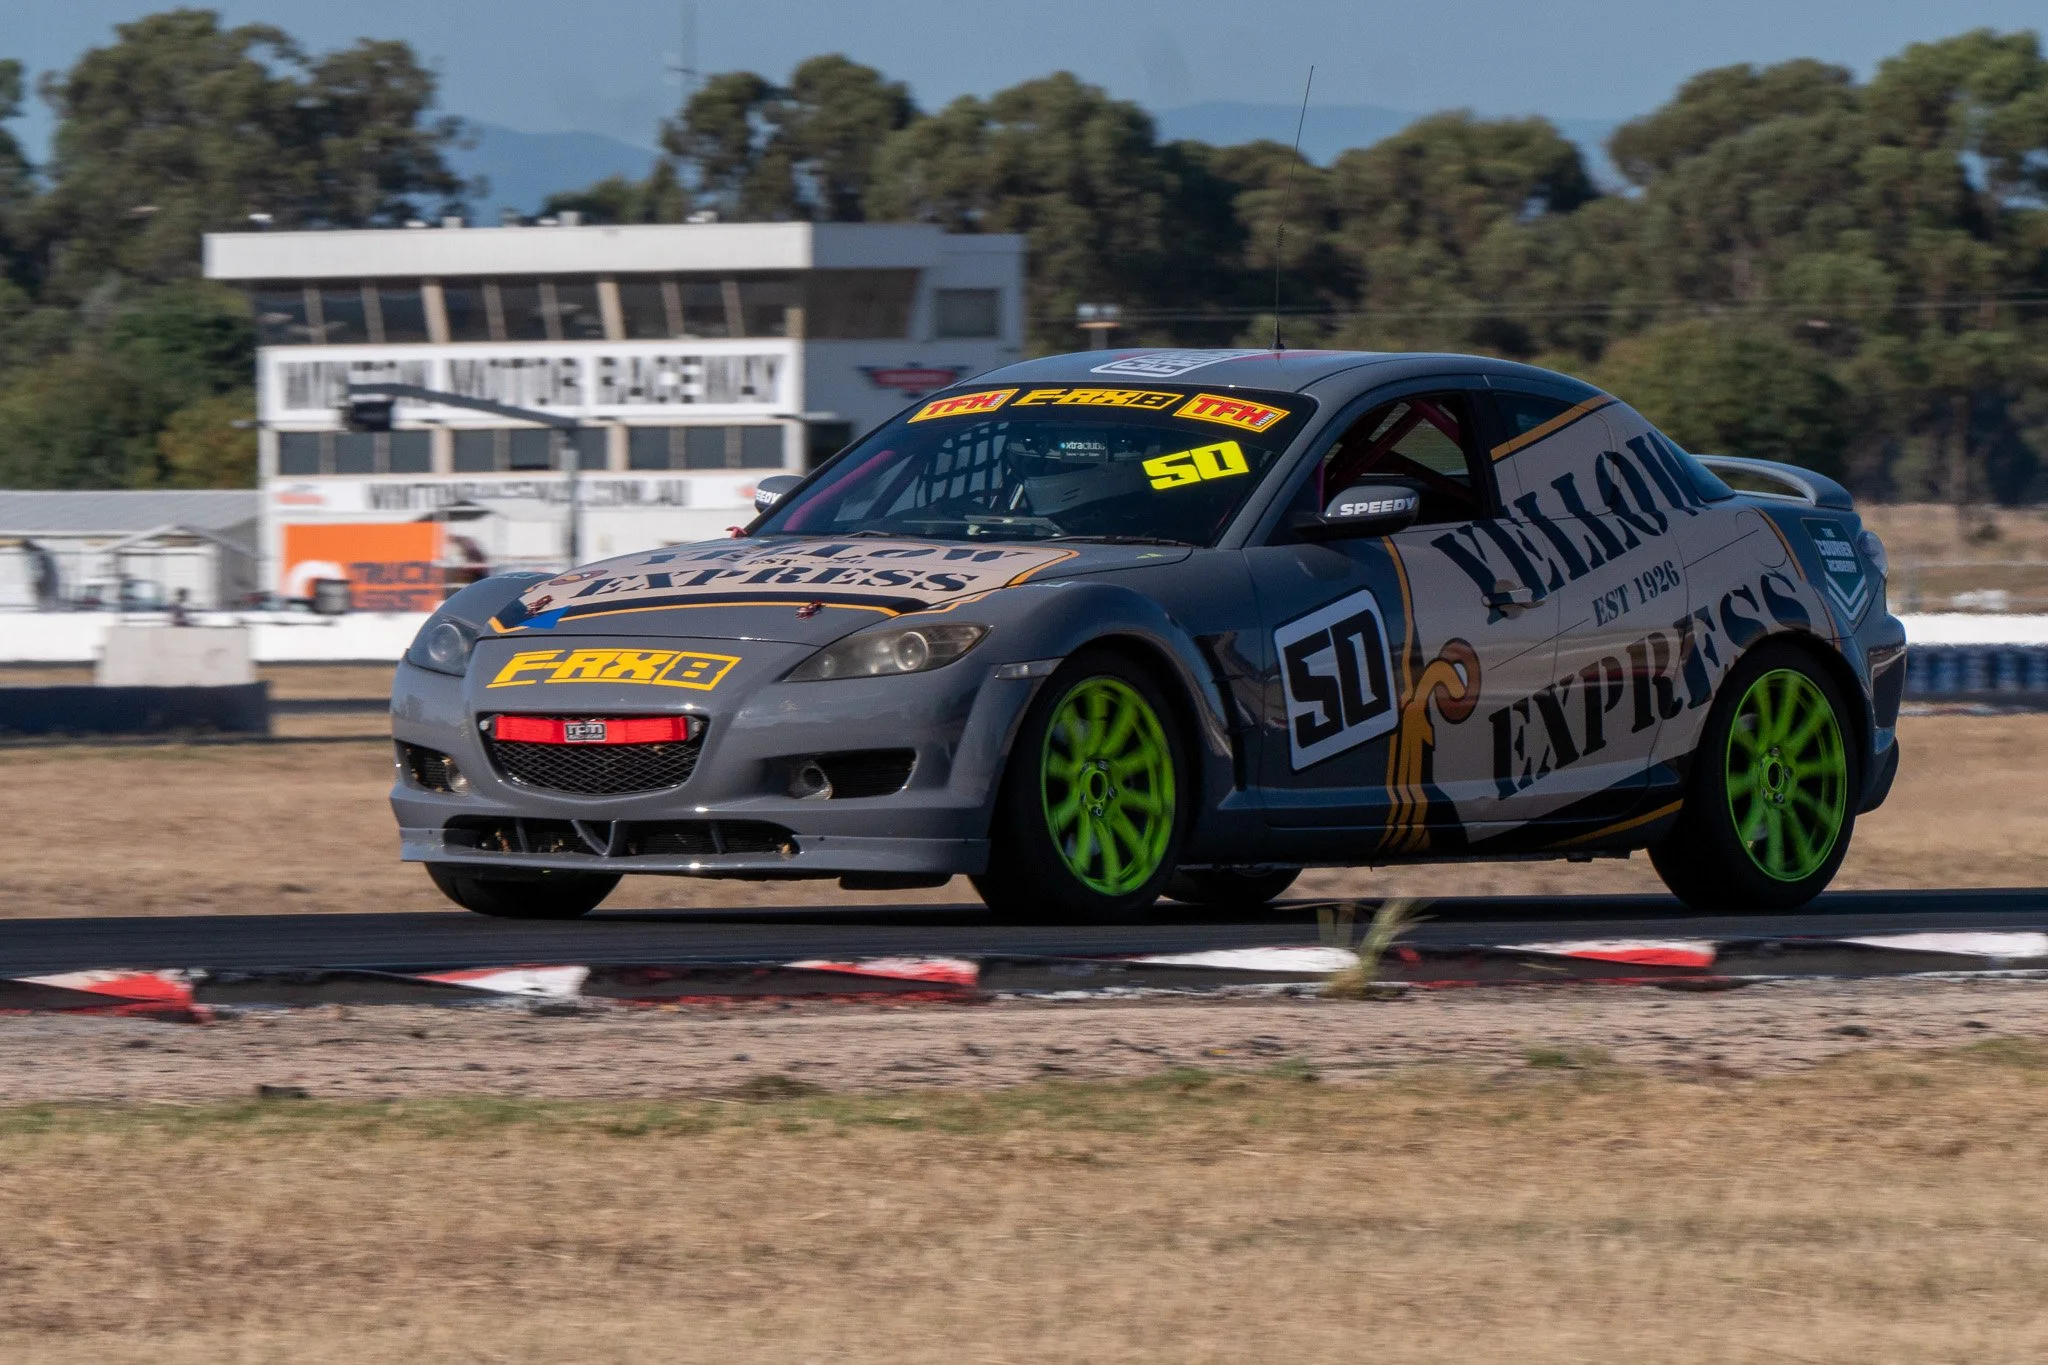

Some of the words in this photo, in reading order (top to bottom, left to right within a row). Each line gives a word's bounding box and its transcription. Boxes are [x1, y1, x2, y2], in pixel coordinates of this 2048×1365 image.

[598, 355, 786, 404] RACEWAY
[926, 393, 1000, 416] TFH
[1192, 397, 1270, 425] TFH
[1142, 440, 1250, 491] 50
[1339, 497, 1416, 516] SPEEDY
[1430, 431, 1712, 636] YELLOW
[569, 566, 980, 599] EXPRESS
[1592, 582, 1629, 628] EST
[1632, 558, 1681, 607] 1926
[1282, 609, 1392, 749] 50
